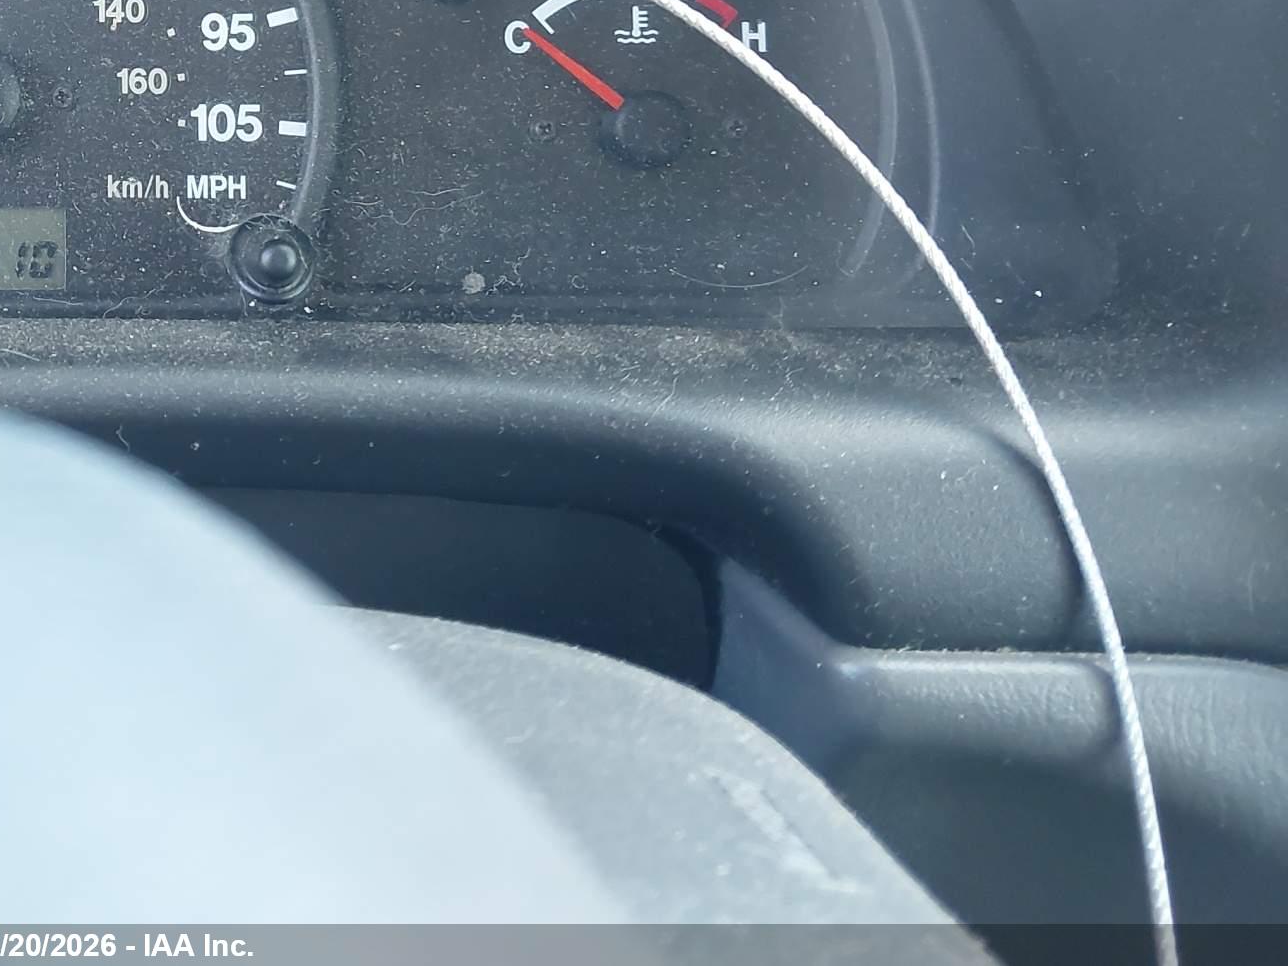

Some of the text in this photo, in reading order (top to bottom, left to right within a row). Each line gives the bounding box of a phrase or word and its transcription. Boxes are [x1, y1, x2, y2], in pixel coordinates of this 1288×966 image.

[201, 12, 256, 52] 95
[504, 20, 532, 54] C
[741, 21, 767, 53] H
[117, 67, 168, 95] 160
[190, 103, 263, 143] 105
[107, 175, 247, 200] km/h MPH
